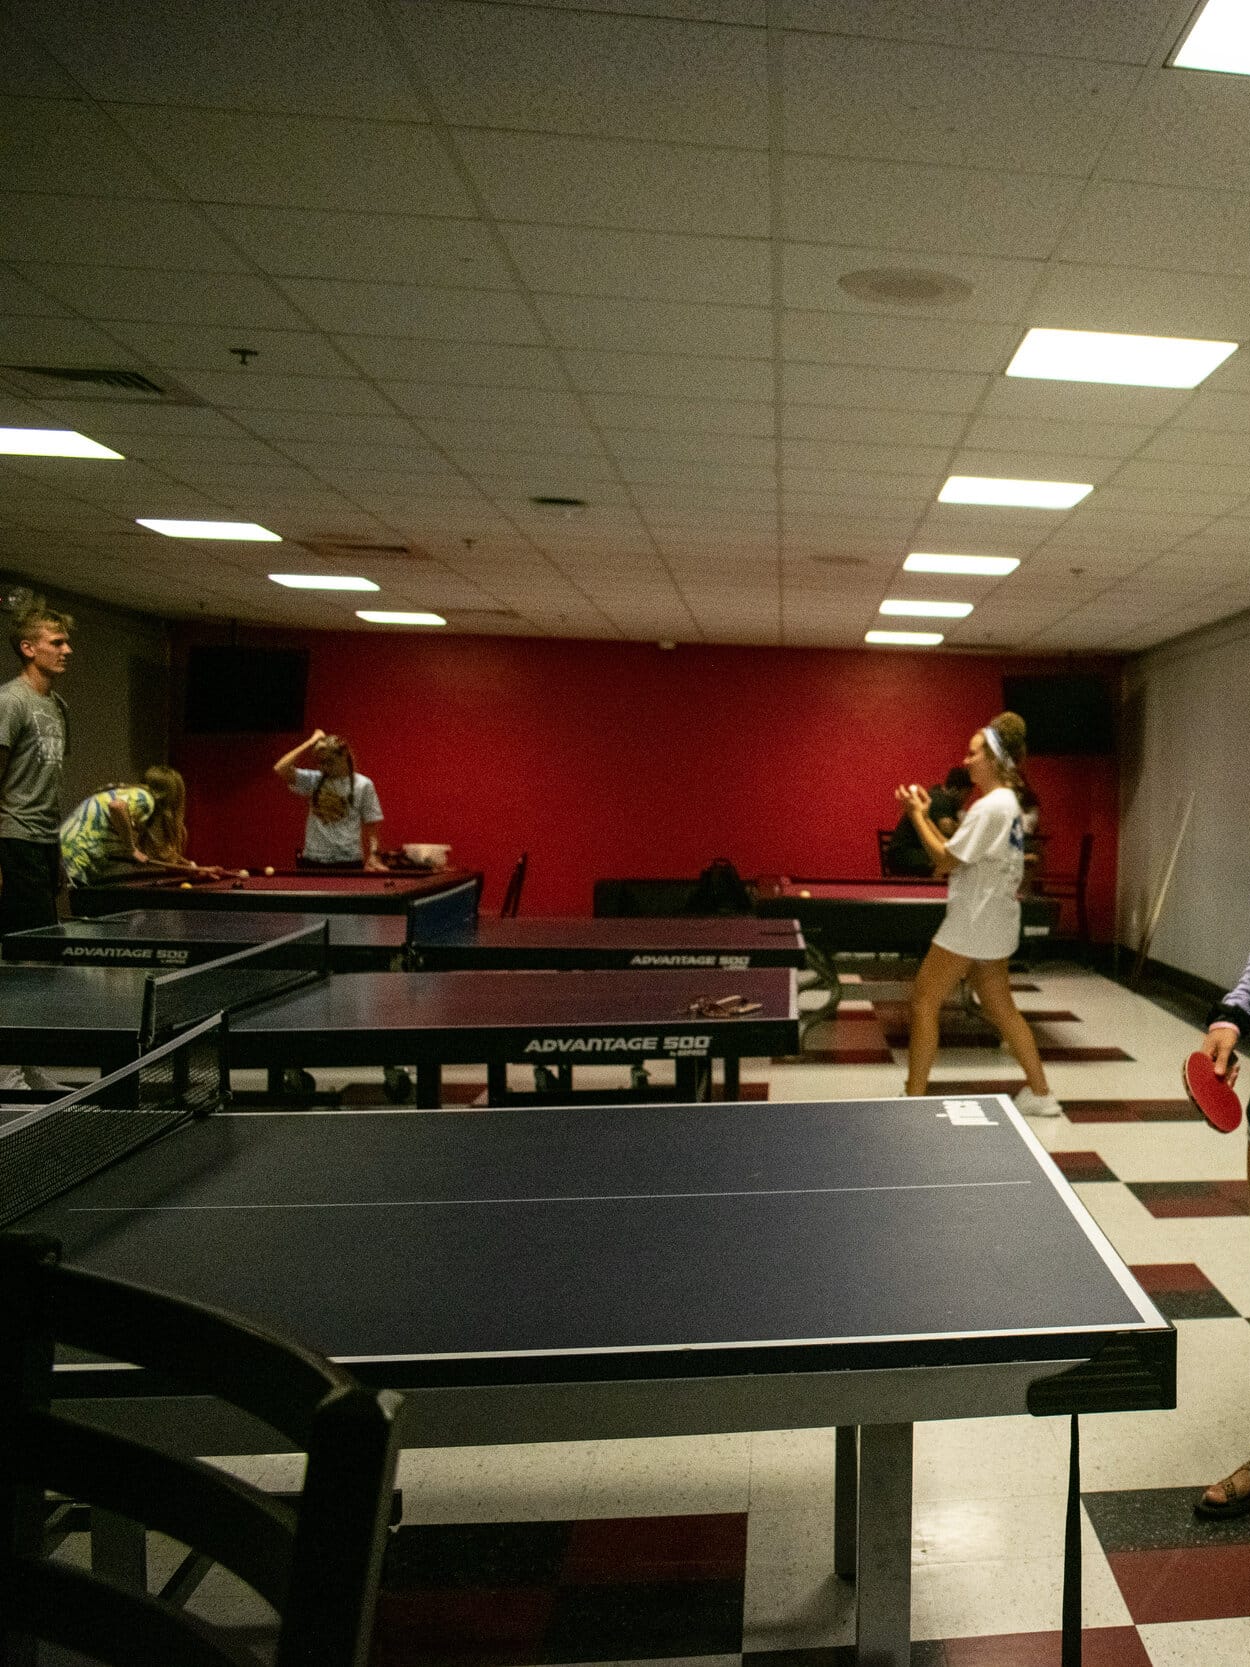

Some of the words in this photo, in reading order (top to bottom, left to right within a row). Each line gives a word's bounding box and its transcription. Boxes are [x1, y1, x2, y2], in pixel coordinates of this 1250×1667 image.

[62, 946, 152, 959] ADVANTAGE
[630, 955, 716, 966] ADVANTAGE
[524, 1036, 658, 1053] ADVANTAGE
[663, 1035, 711, 1049] 500
